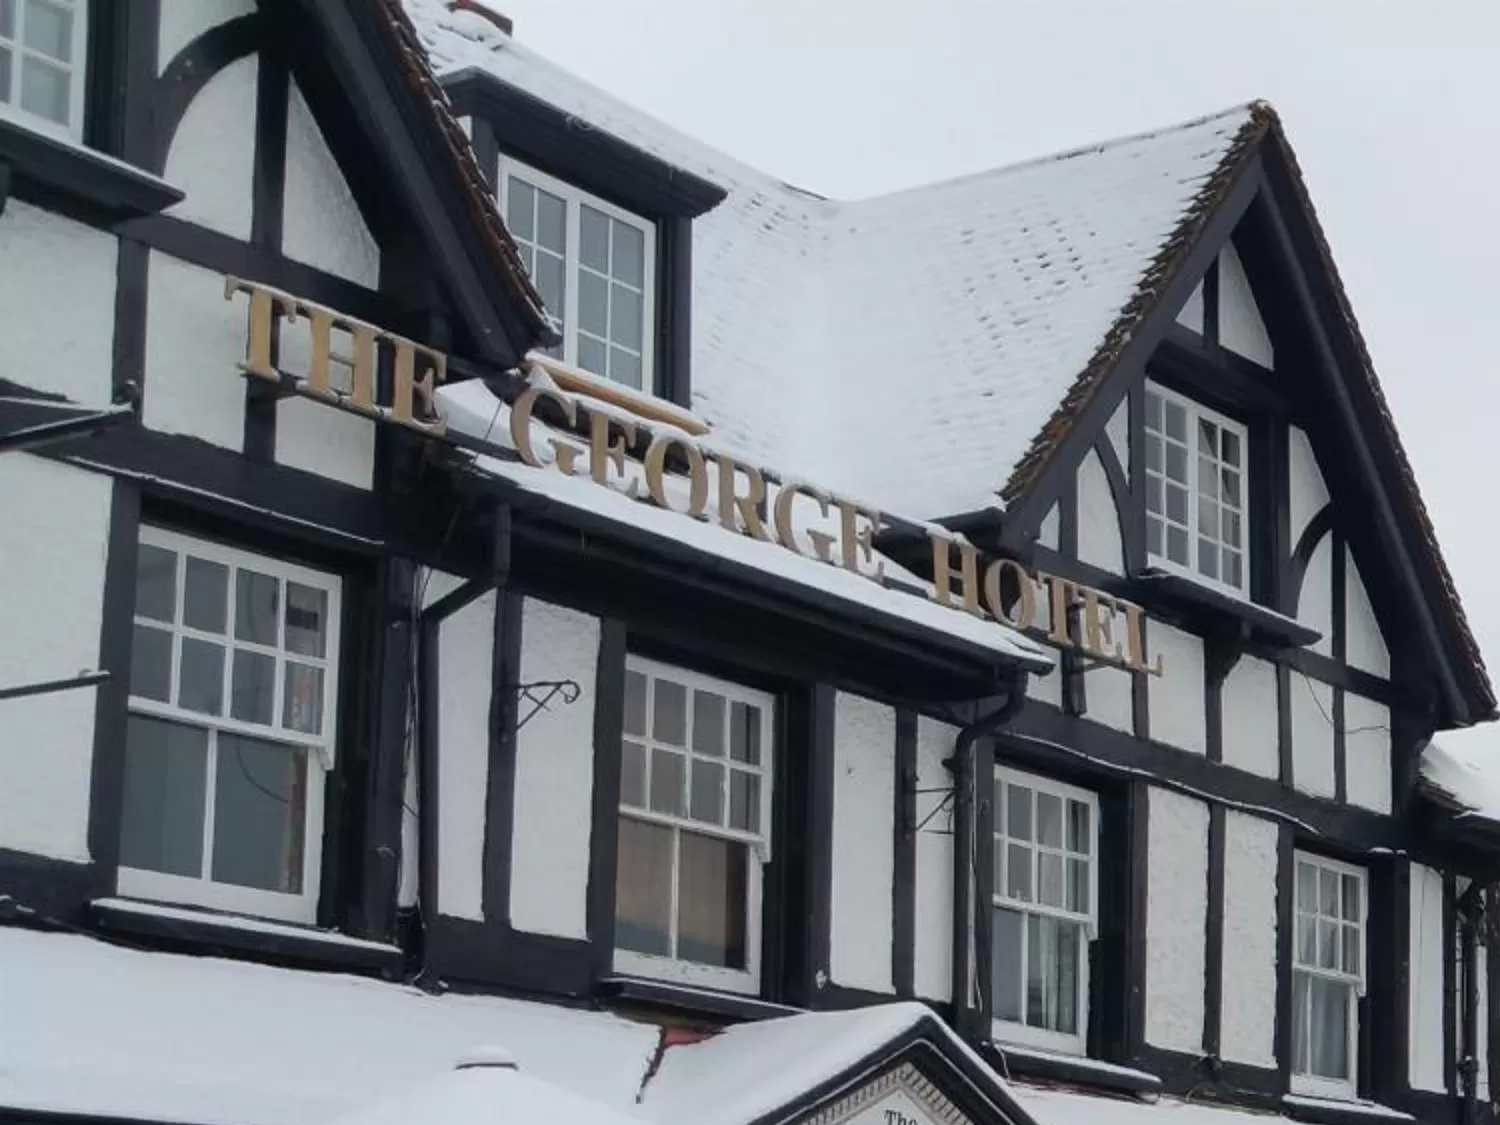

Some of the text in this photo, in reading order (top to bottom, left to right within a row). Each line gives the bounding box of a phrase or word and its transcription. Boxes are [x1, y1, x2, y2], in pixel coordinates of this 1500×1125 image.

[223, 275, 1163, 678] THE GEORGE HOTEL
